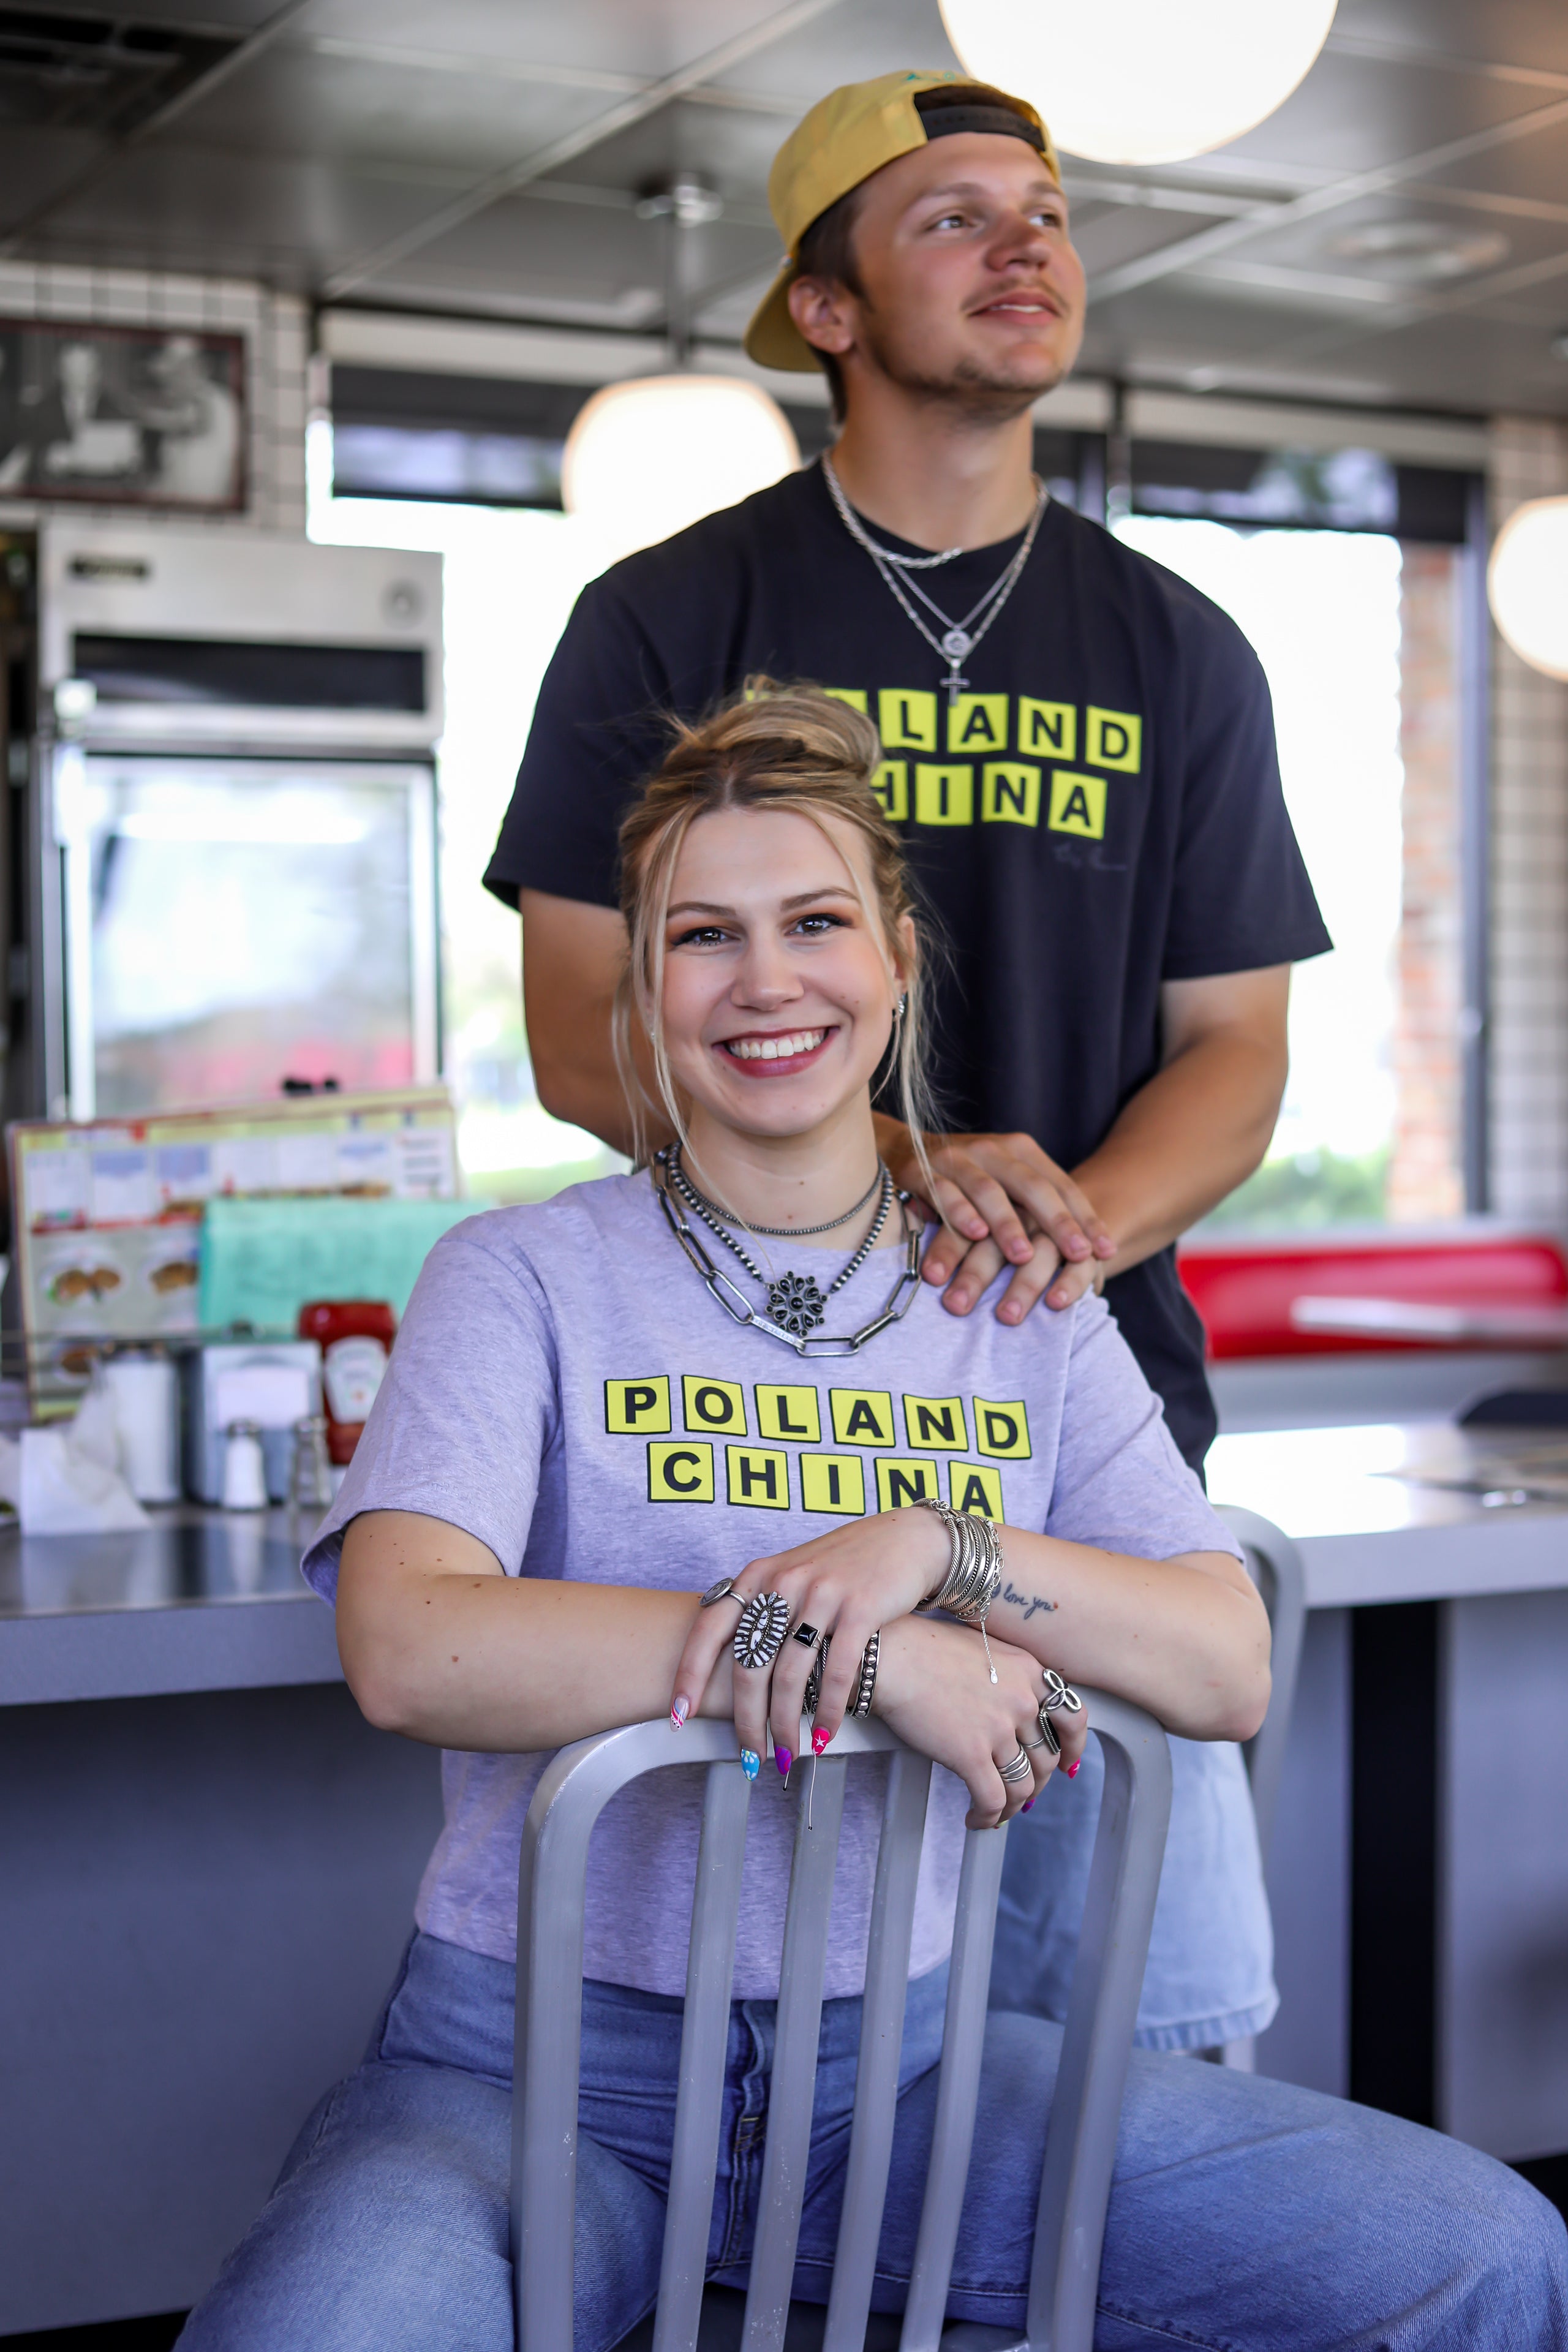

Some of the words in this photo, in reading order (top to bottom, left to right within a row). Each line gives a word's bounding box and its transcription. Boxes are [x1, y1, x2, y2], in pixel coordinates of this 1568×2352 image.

[900, 700, 1129, 760] LAND
[870, 771, 1091, 827] HINA
[625, 1386, 1018, 1449] POLAND
[663, 1451, 993, 1517] CHINA
[1003, 1583, 1028, 1605] love
[1023, 1597, 1054, 1620] you
